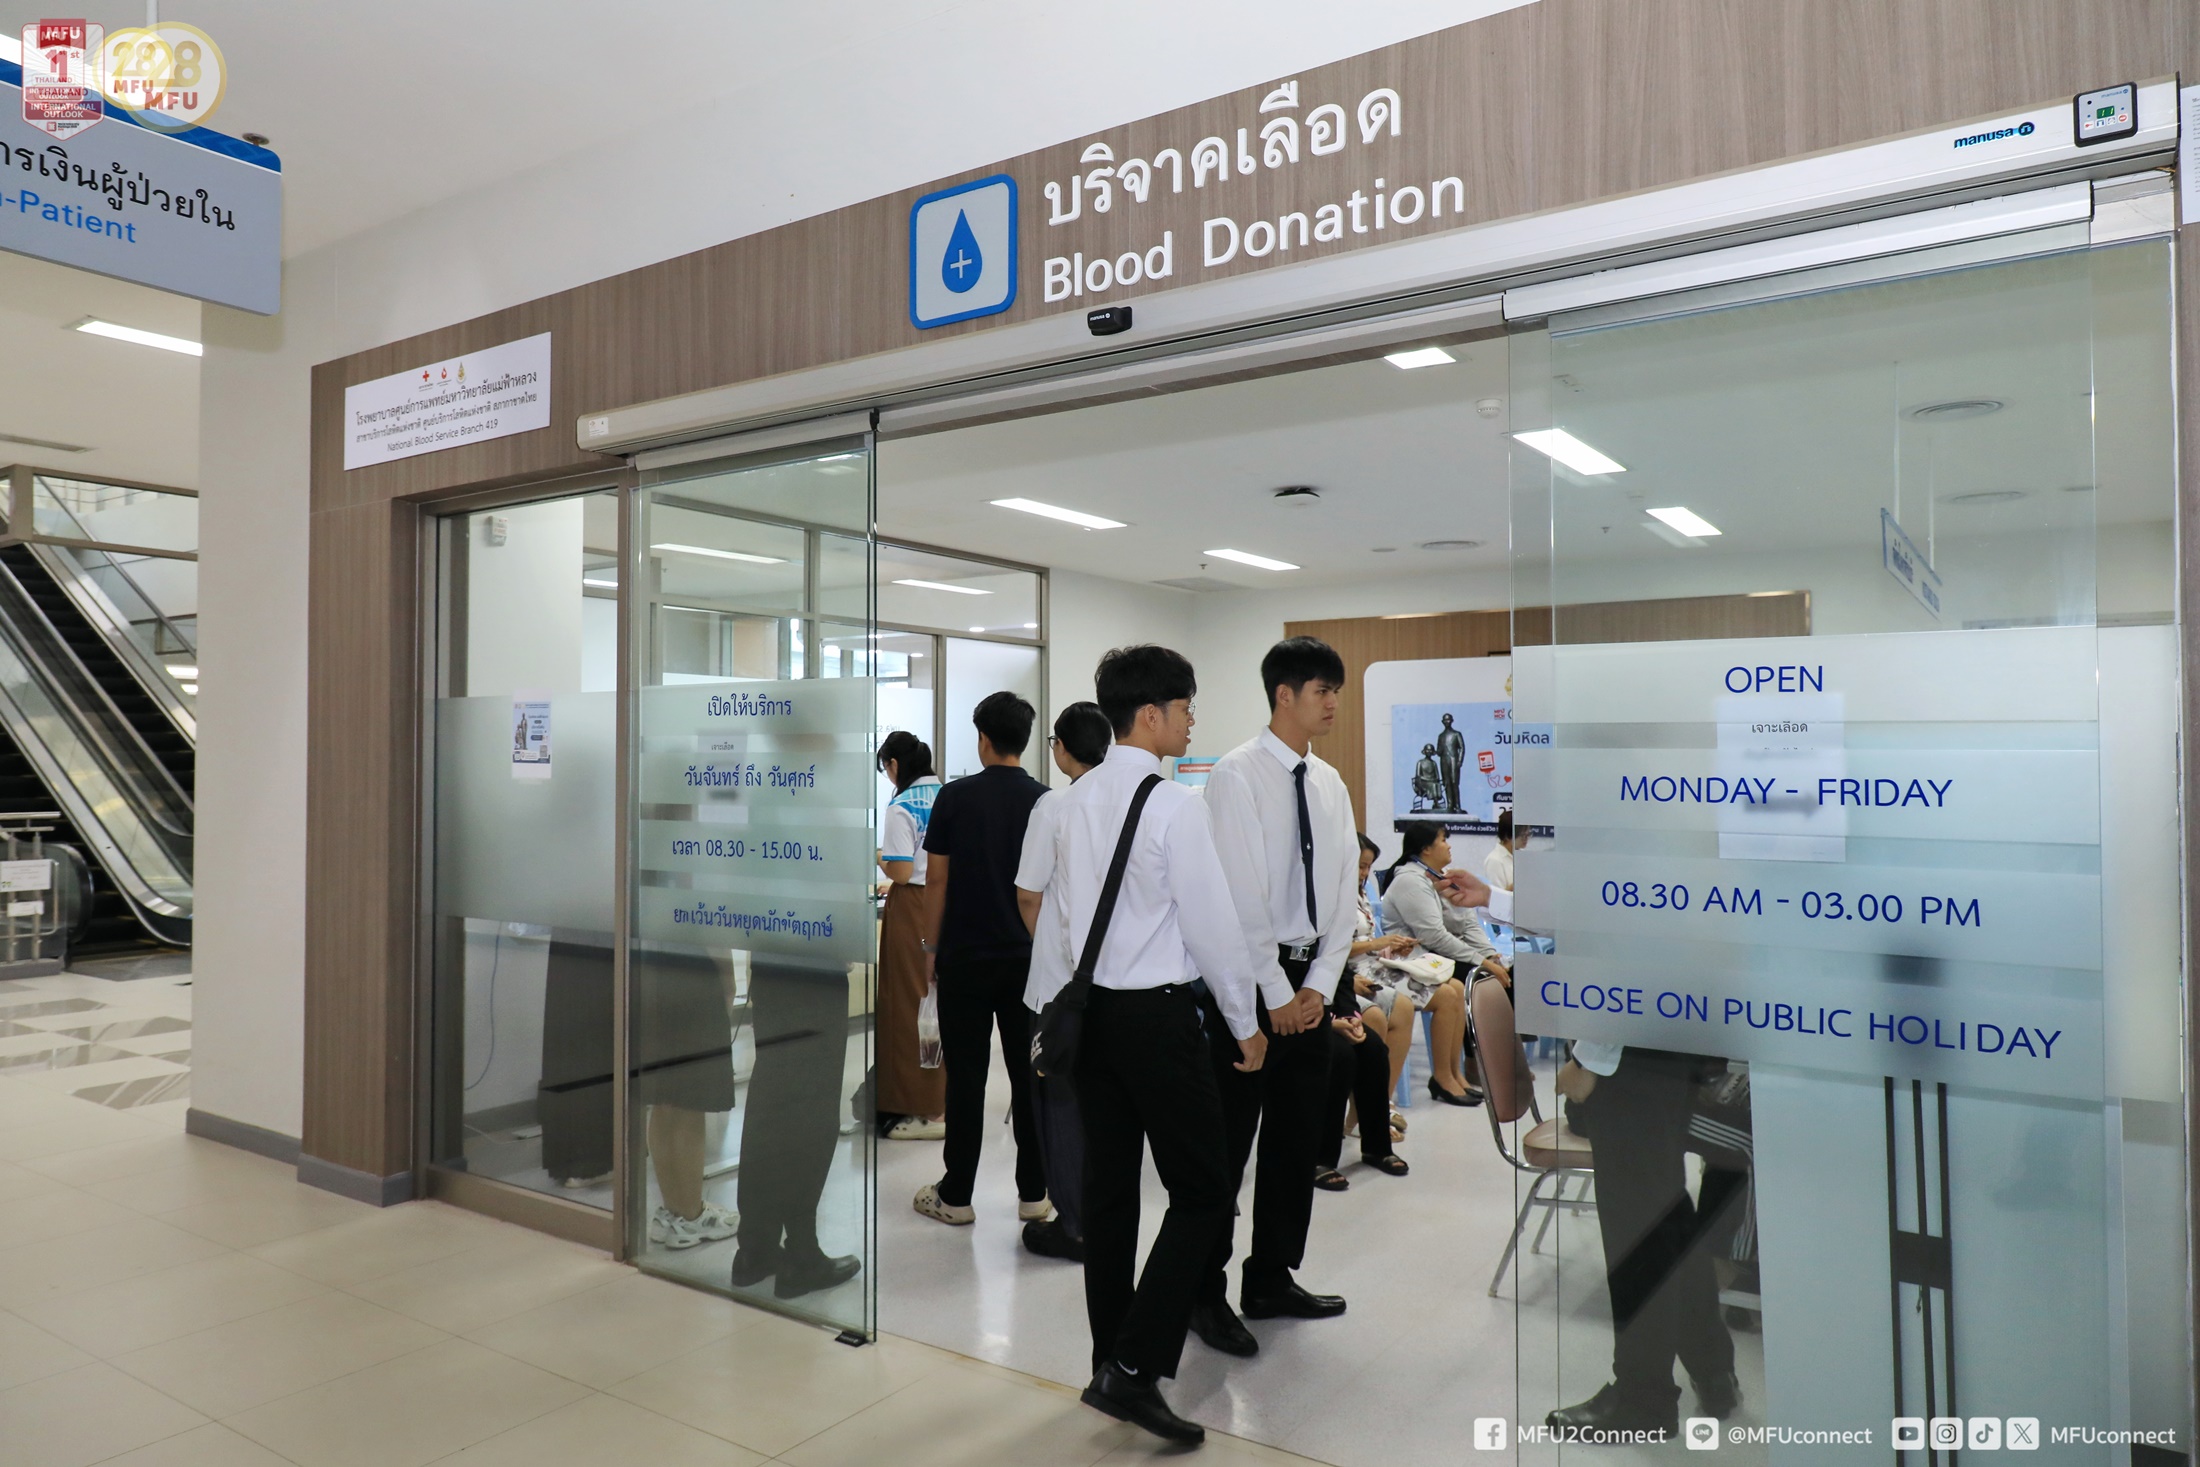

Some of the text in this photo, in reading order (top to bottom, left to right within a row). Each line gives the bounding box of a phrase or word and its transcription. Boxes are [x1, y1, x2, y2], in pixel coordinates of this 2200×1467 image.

[1043, 80, 1401, 226] บริจาคเลือด
[1953, 128, 2014, 148] manusa
[1043, 175, 1465, 303] Blood Donation
[387, 418, 498, 452] National Blood Service Branch 419
[1724, 665, 1824, 694] OPEN
[707, 693, 792, 717] เปิดให้บริการ
[1751, 720, 1809, 734] เจาะเลือด
[684, 763, 815, 796] วันจันทร์ ถึง วันศุกร์
[1620, 775, 1776, 805] MONDAY
[1817, 778, 1953, 807] FRIDAY
[672, 840, 701, 856] เวลา
[705, 839, 745, 858] 08.30
[761, 841, 802, 860] 15.00
[808, 844, 824, 861] น.
[1601, 881, 1690, 911] 08.30
[1703, 886, 1763, 916] AM
[1801, 891, 1903, 923] 03.00
[1920, 896, 1981, 928] PM
[1540, 980, 2062, 1060] CLOSE ON PUBLIC HOLIDAY
